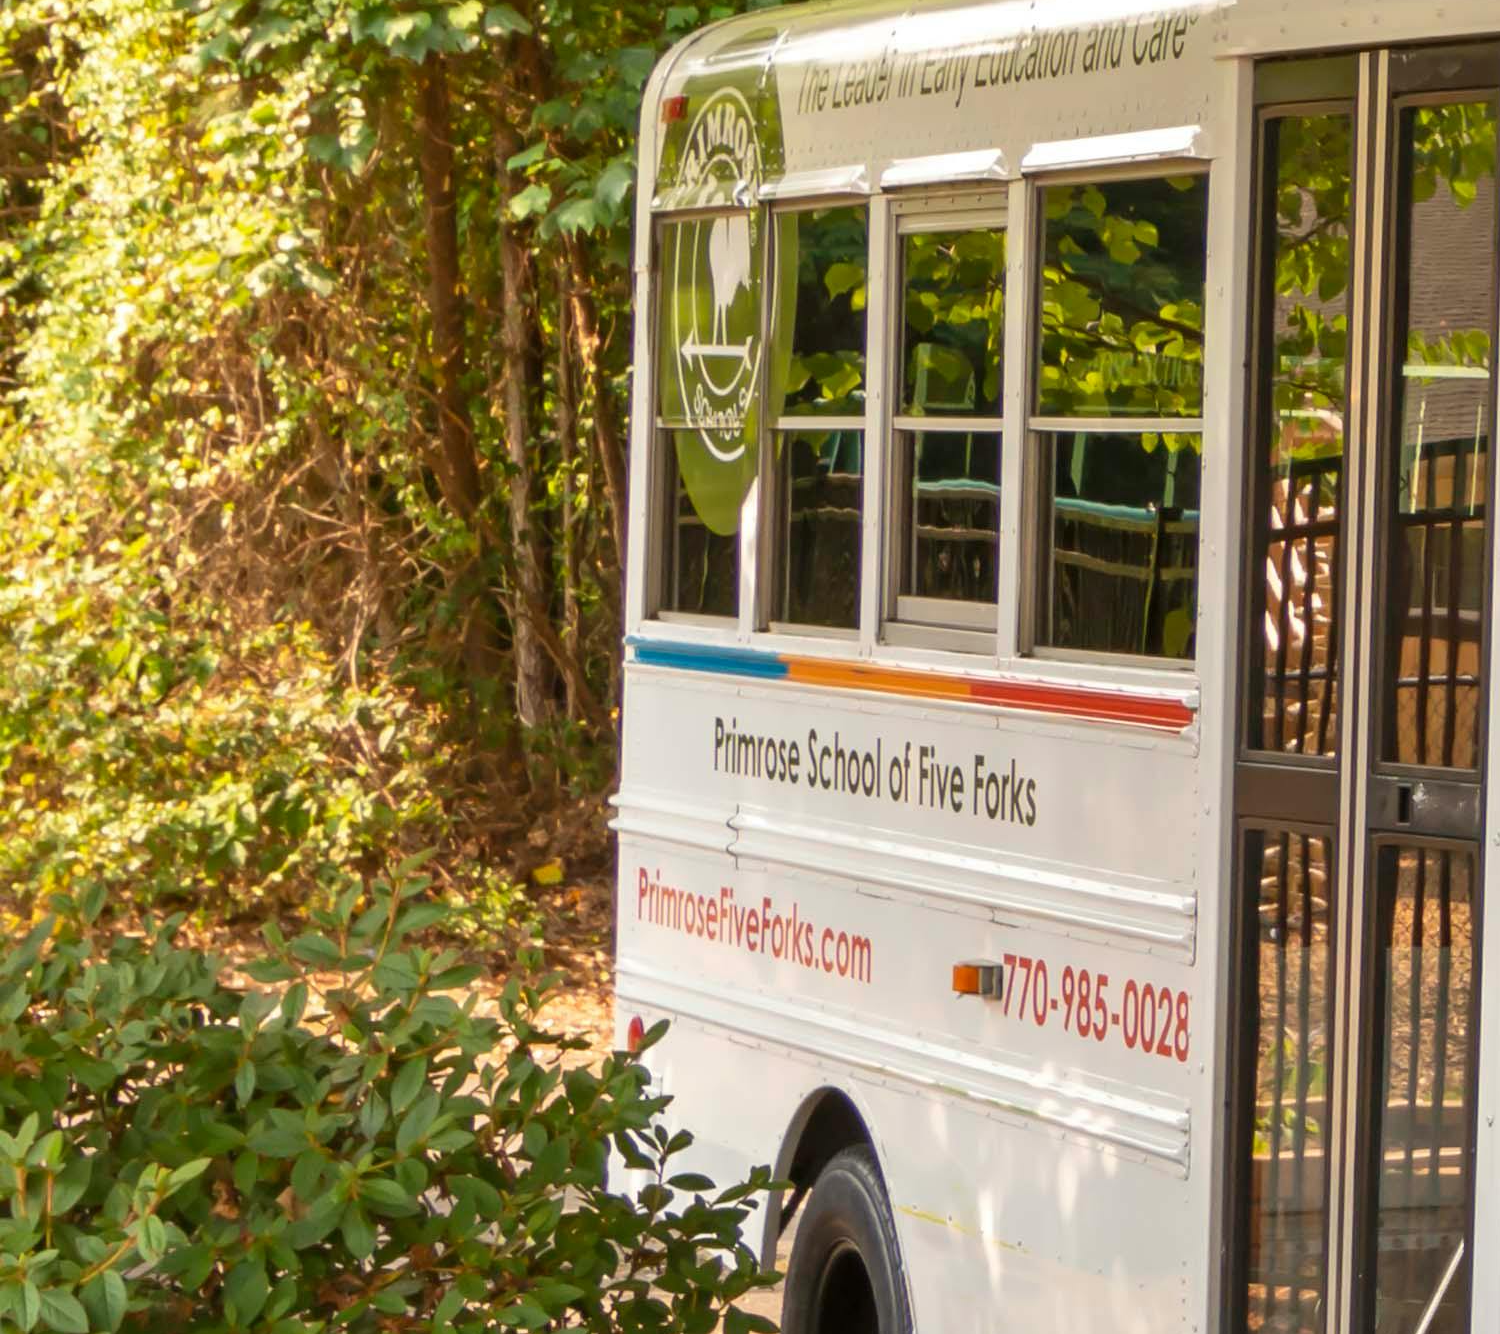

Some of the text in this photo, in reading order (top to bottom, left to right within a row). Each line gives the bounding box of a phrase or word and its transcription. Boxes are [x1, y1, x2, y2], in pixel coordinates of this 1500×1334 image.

[714, 717, 1037, 827] Primrose School of Five Forks
[637, 866, 872, 985] PrimroseFiveForks.com
[1003, 953, 1190, 1062] 770-985-0028
